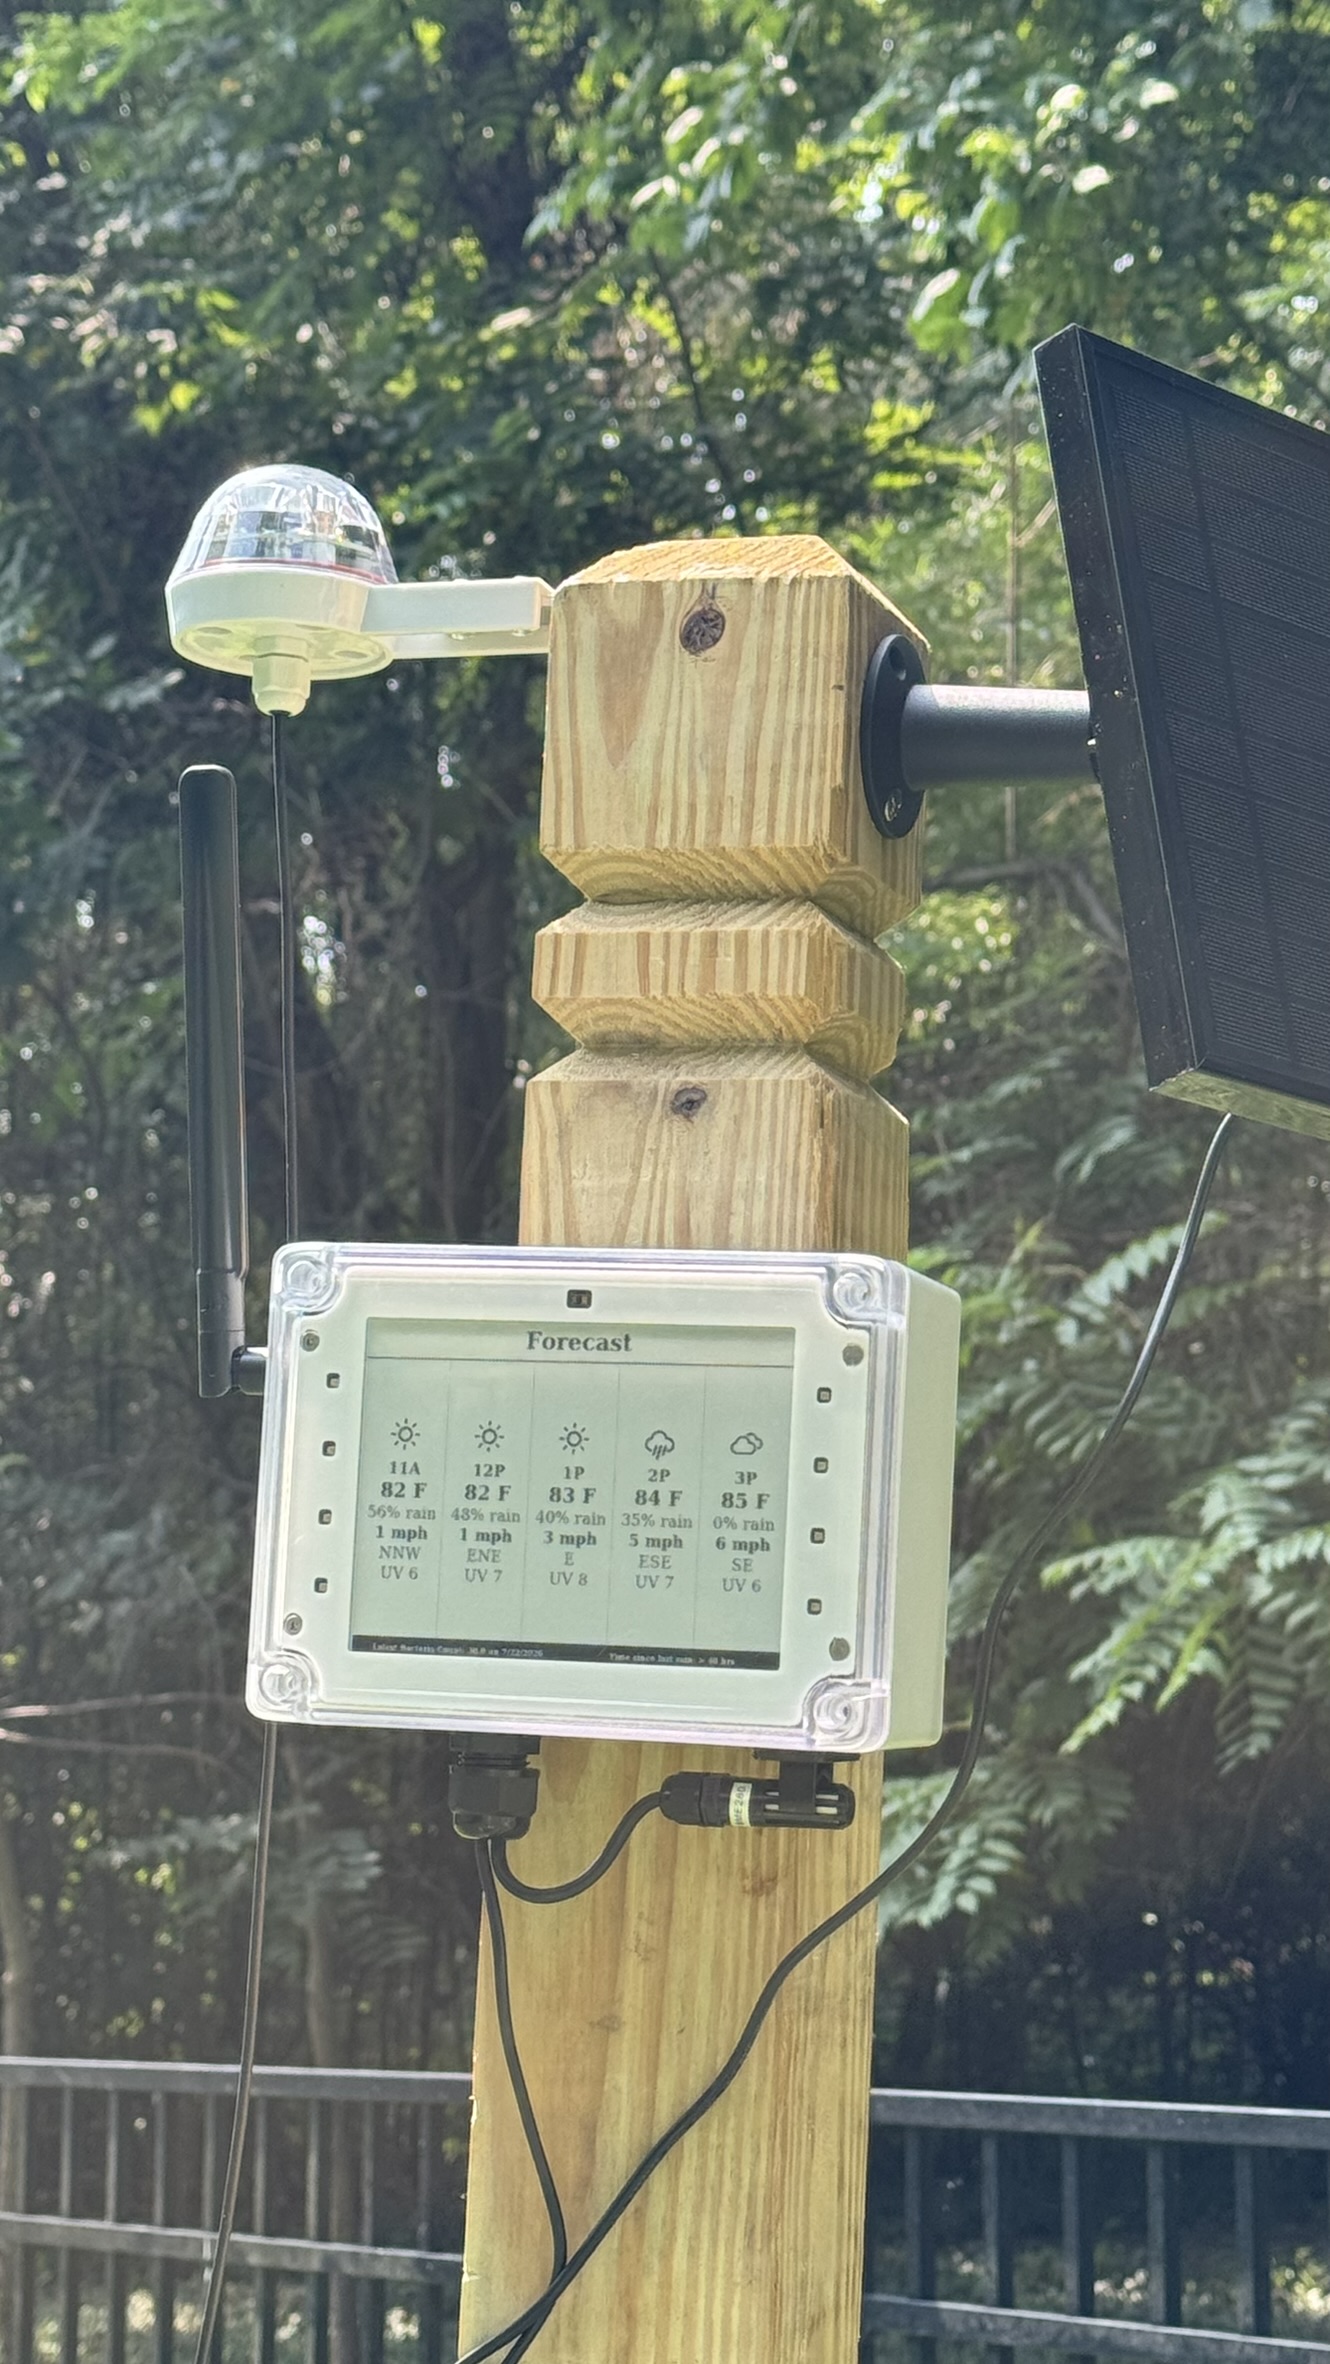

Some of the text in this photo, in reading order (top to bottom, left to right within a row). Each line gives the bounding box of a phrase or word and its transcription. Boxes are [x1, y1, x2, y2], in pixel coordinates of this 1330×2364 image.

[526, 1331, 633, 1352] Forecast
[389, 1461, 421, 1475] 11A
[474, 1463, 506, 1477] 12P
[563, 1466, 585, 1480] 1P
[647, 1468, 671, 1483] 2P
[734, 1471, 758, 1485] 3P
[380, 1482, 427, 1499] 82 F
[464, 1484, 512, 1501] 82 F
[548, 1487, 596, 1504] 83 F
[634, 1489, 683, 1506] 84 F
[721, 1492, 770, 1510] 85 F
[367, 1504, 436, 1520] 56% rain
[450, 1507, 521, 1523] 48% rain
[535, 1510, 606, 1526] 40% rain
[621, 1513, 693, 1529] 35% rain
[712, 1516, 775, 1531] 0% rain
[375, 1525, 428, 1543] 1 mph
[459, 1527, 512, 1546] 1 mph
[543, 1531, 597, 1549] 3 mph
[628, 1533, 683, 1552] 5 mph
[715, 1536, 771, 1555] 6 mph
[378, 1546, 421, 1560] NNW
[466, 1548, 502, 1563] ENE
[564, 1552, 574, 1566] E
[638, 1554, 672, 1570] ESE
[731, 1558, 753, 1572] SE
[380, 1566, 418, 1580] UV 6
[464, 1568, 503, 1582] UV 7
[549, 1571, 588, 1586] UV 8
[635, 1575, 674, 1589] UV 7
[722, 1578, 761, 1593] UV 6
[720, 1657, 735, 1666] hrs
